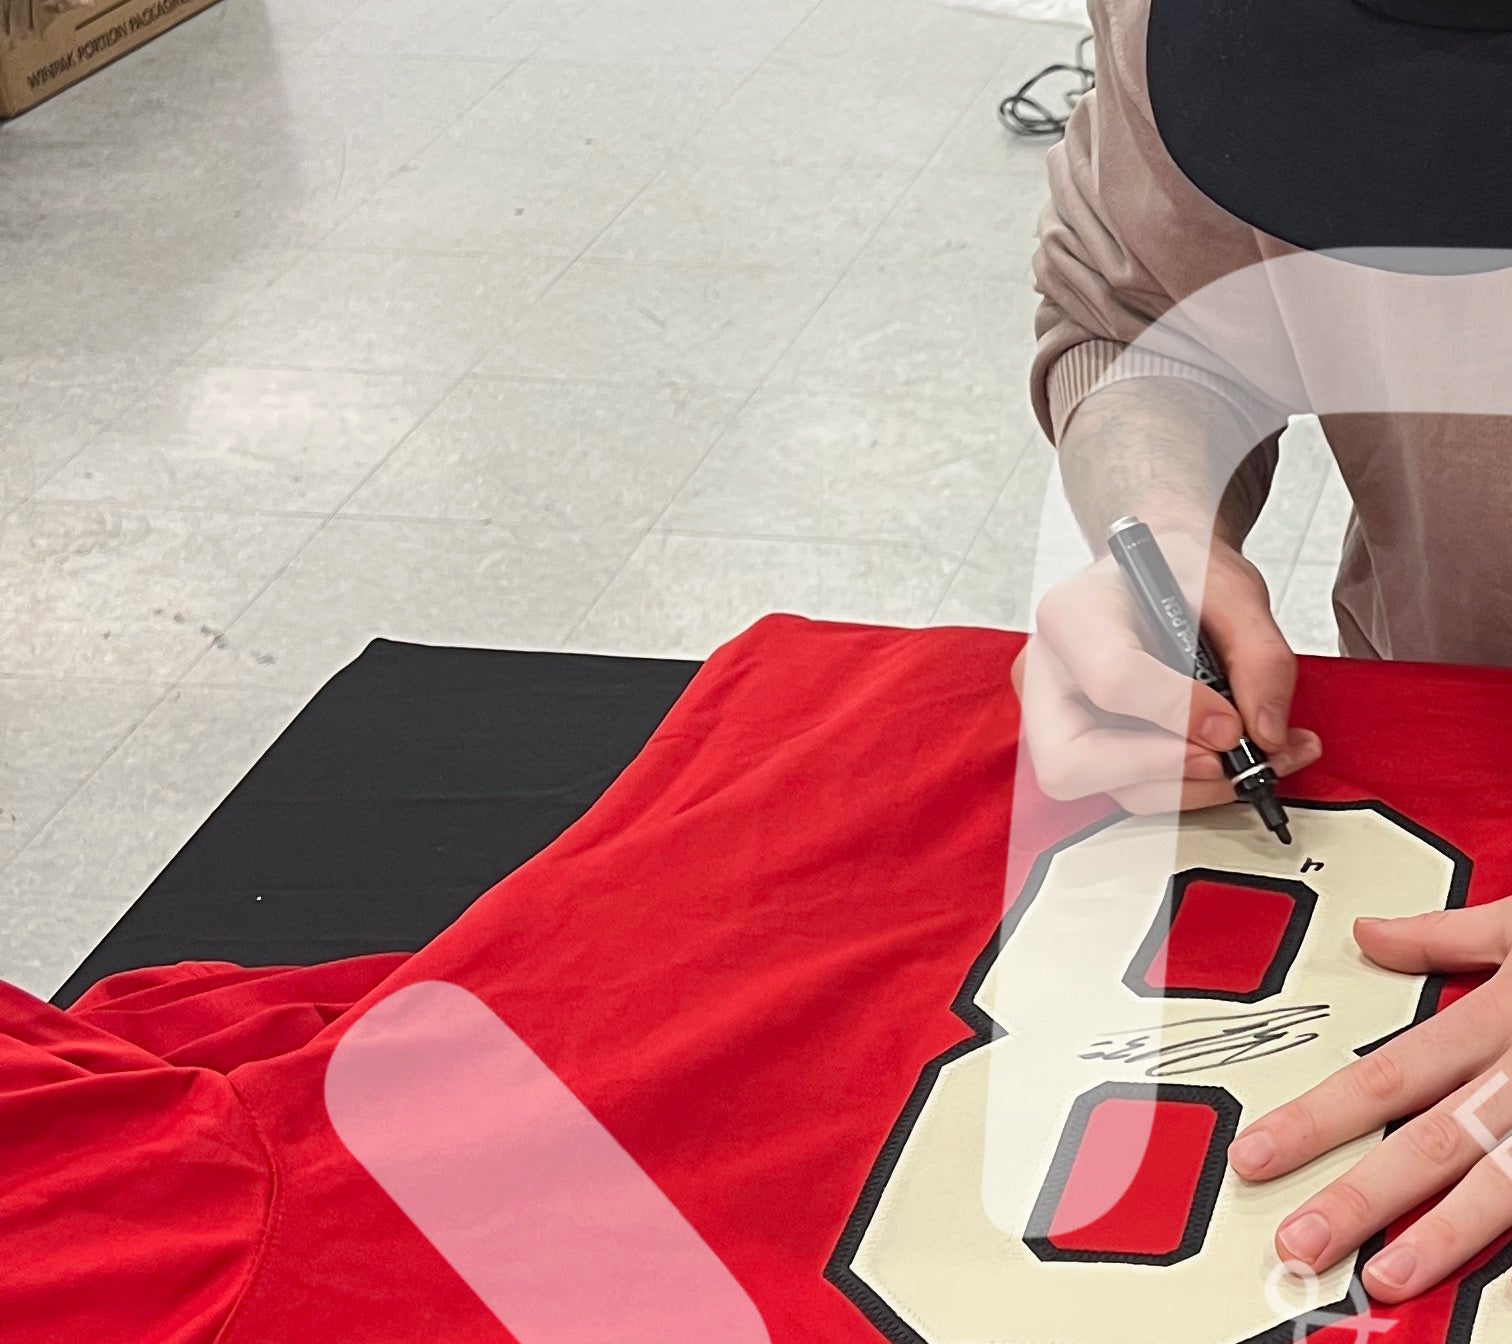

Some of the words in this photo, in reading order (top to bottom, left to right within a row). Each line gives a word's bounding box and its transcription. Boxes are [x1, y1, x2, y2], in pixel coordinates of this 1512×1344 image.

[27, 50, 75, 88] WINPAK
[77, 21, 128, 62] PORTION
[1161, 596, 1188, 627] PEN
